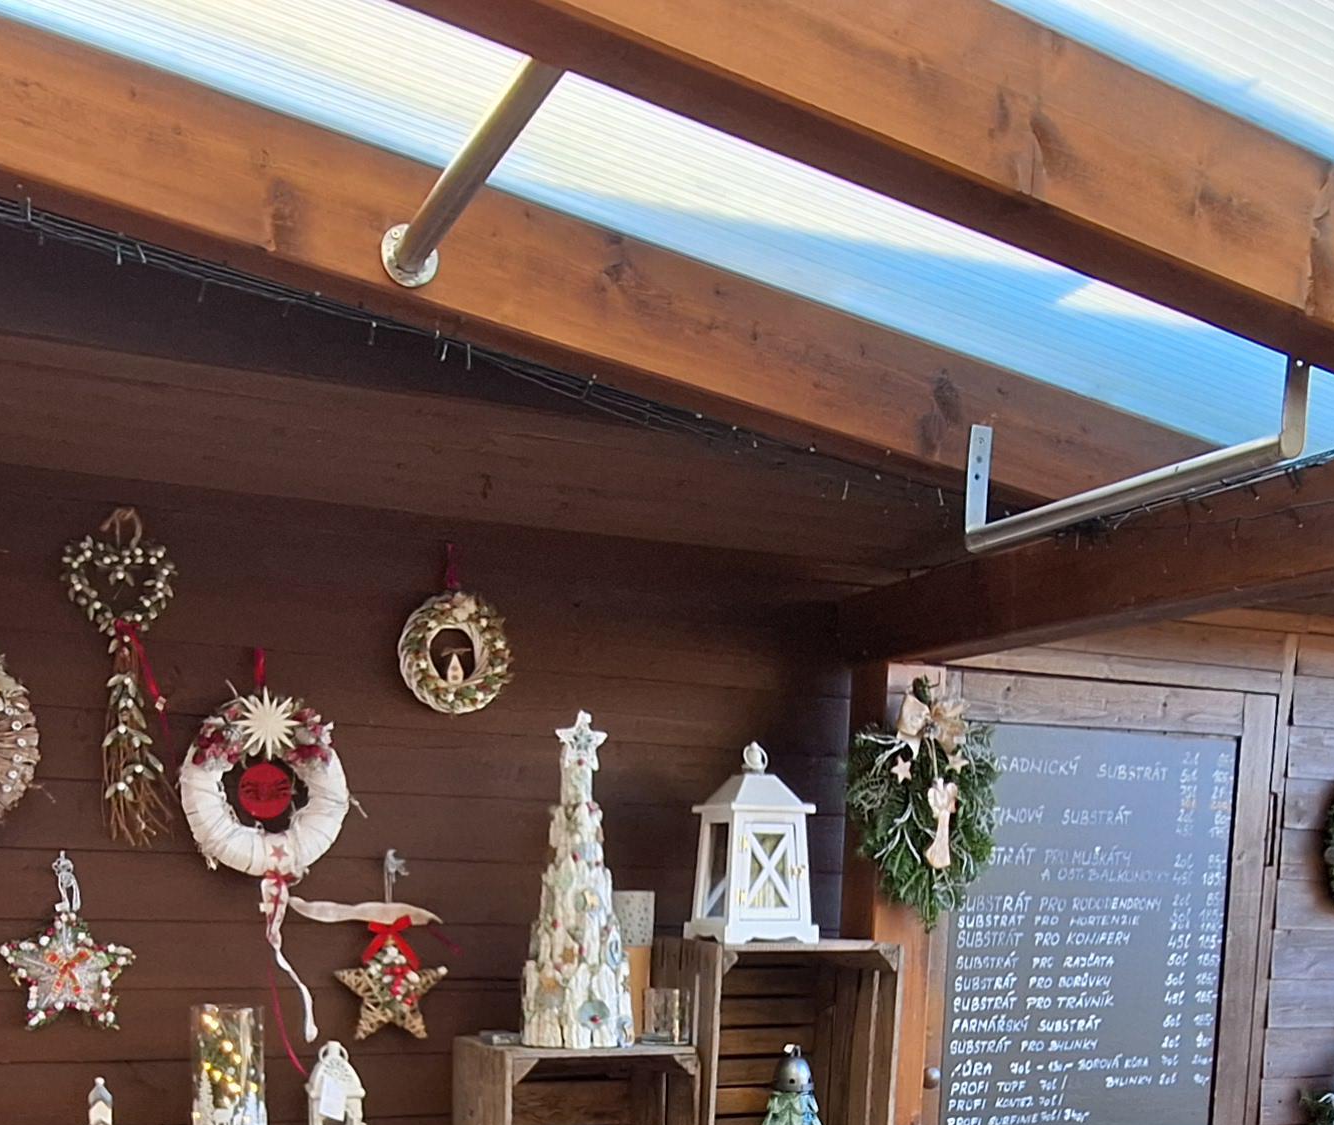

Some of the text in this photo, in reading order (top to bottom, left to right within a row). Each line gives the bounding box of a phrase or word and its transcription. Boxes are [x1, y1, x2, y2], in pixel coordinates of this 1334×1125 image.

[993, 756, 1168, 781] RADNICKÝ SUBSTRÁT
[992, 805, 1133, 826] TINOVÝ SUBSTRÁT
[988, 843, 1036, 866] STRÁT
[1041, 868, 1051, 881] A
[958, 889, 1032, 913] SUBSTRÁT
[1039, 896, 1067, 913] PRO
[1034, 915, 1060, 927] PRO
[956, 928, 1024, 949] SUBSTRÁT
[1034, 931, 1060, 947] PRO
[1066, 930, 1131, 946] KONIFERY
[956, 950, 1020, 970] SUBSTRÁT
[1032, 955, 1055, 969] PRO
[1063, 952, 1115, 969] RAJČATA
[955, 971, 1018, 993] SUBSTRÁT
[1028, 975, 1053, 989] PRO
[1058, 972, 1112, 989] BORŮVKY
[953, 990, 1018, 1013] SUBSTRÁT
[1026, 996, 1052, 1010] PRO
[1057, 989, 1115, 1009] TRÁVNÍK
[951, 1014, 1030, 1034] FARMÁŘSKÝ
[1037, 1014, 1102, 1033] SUBSTRÁT
[949, 1035, 1012, 1056] SUBSTRÁT
[1020, 1040, 1045, 1053] PRO
[1048, 1038, 1099, 1052] BYLINKY
[950, 1080, 989, 1096] PROFI
[996, 1080, 1027, 1093] TOPF
[948, 1098, 986, 1112] PROFI
